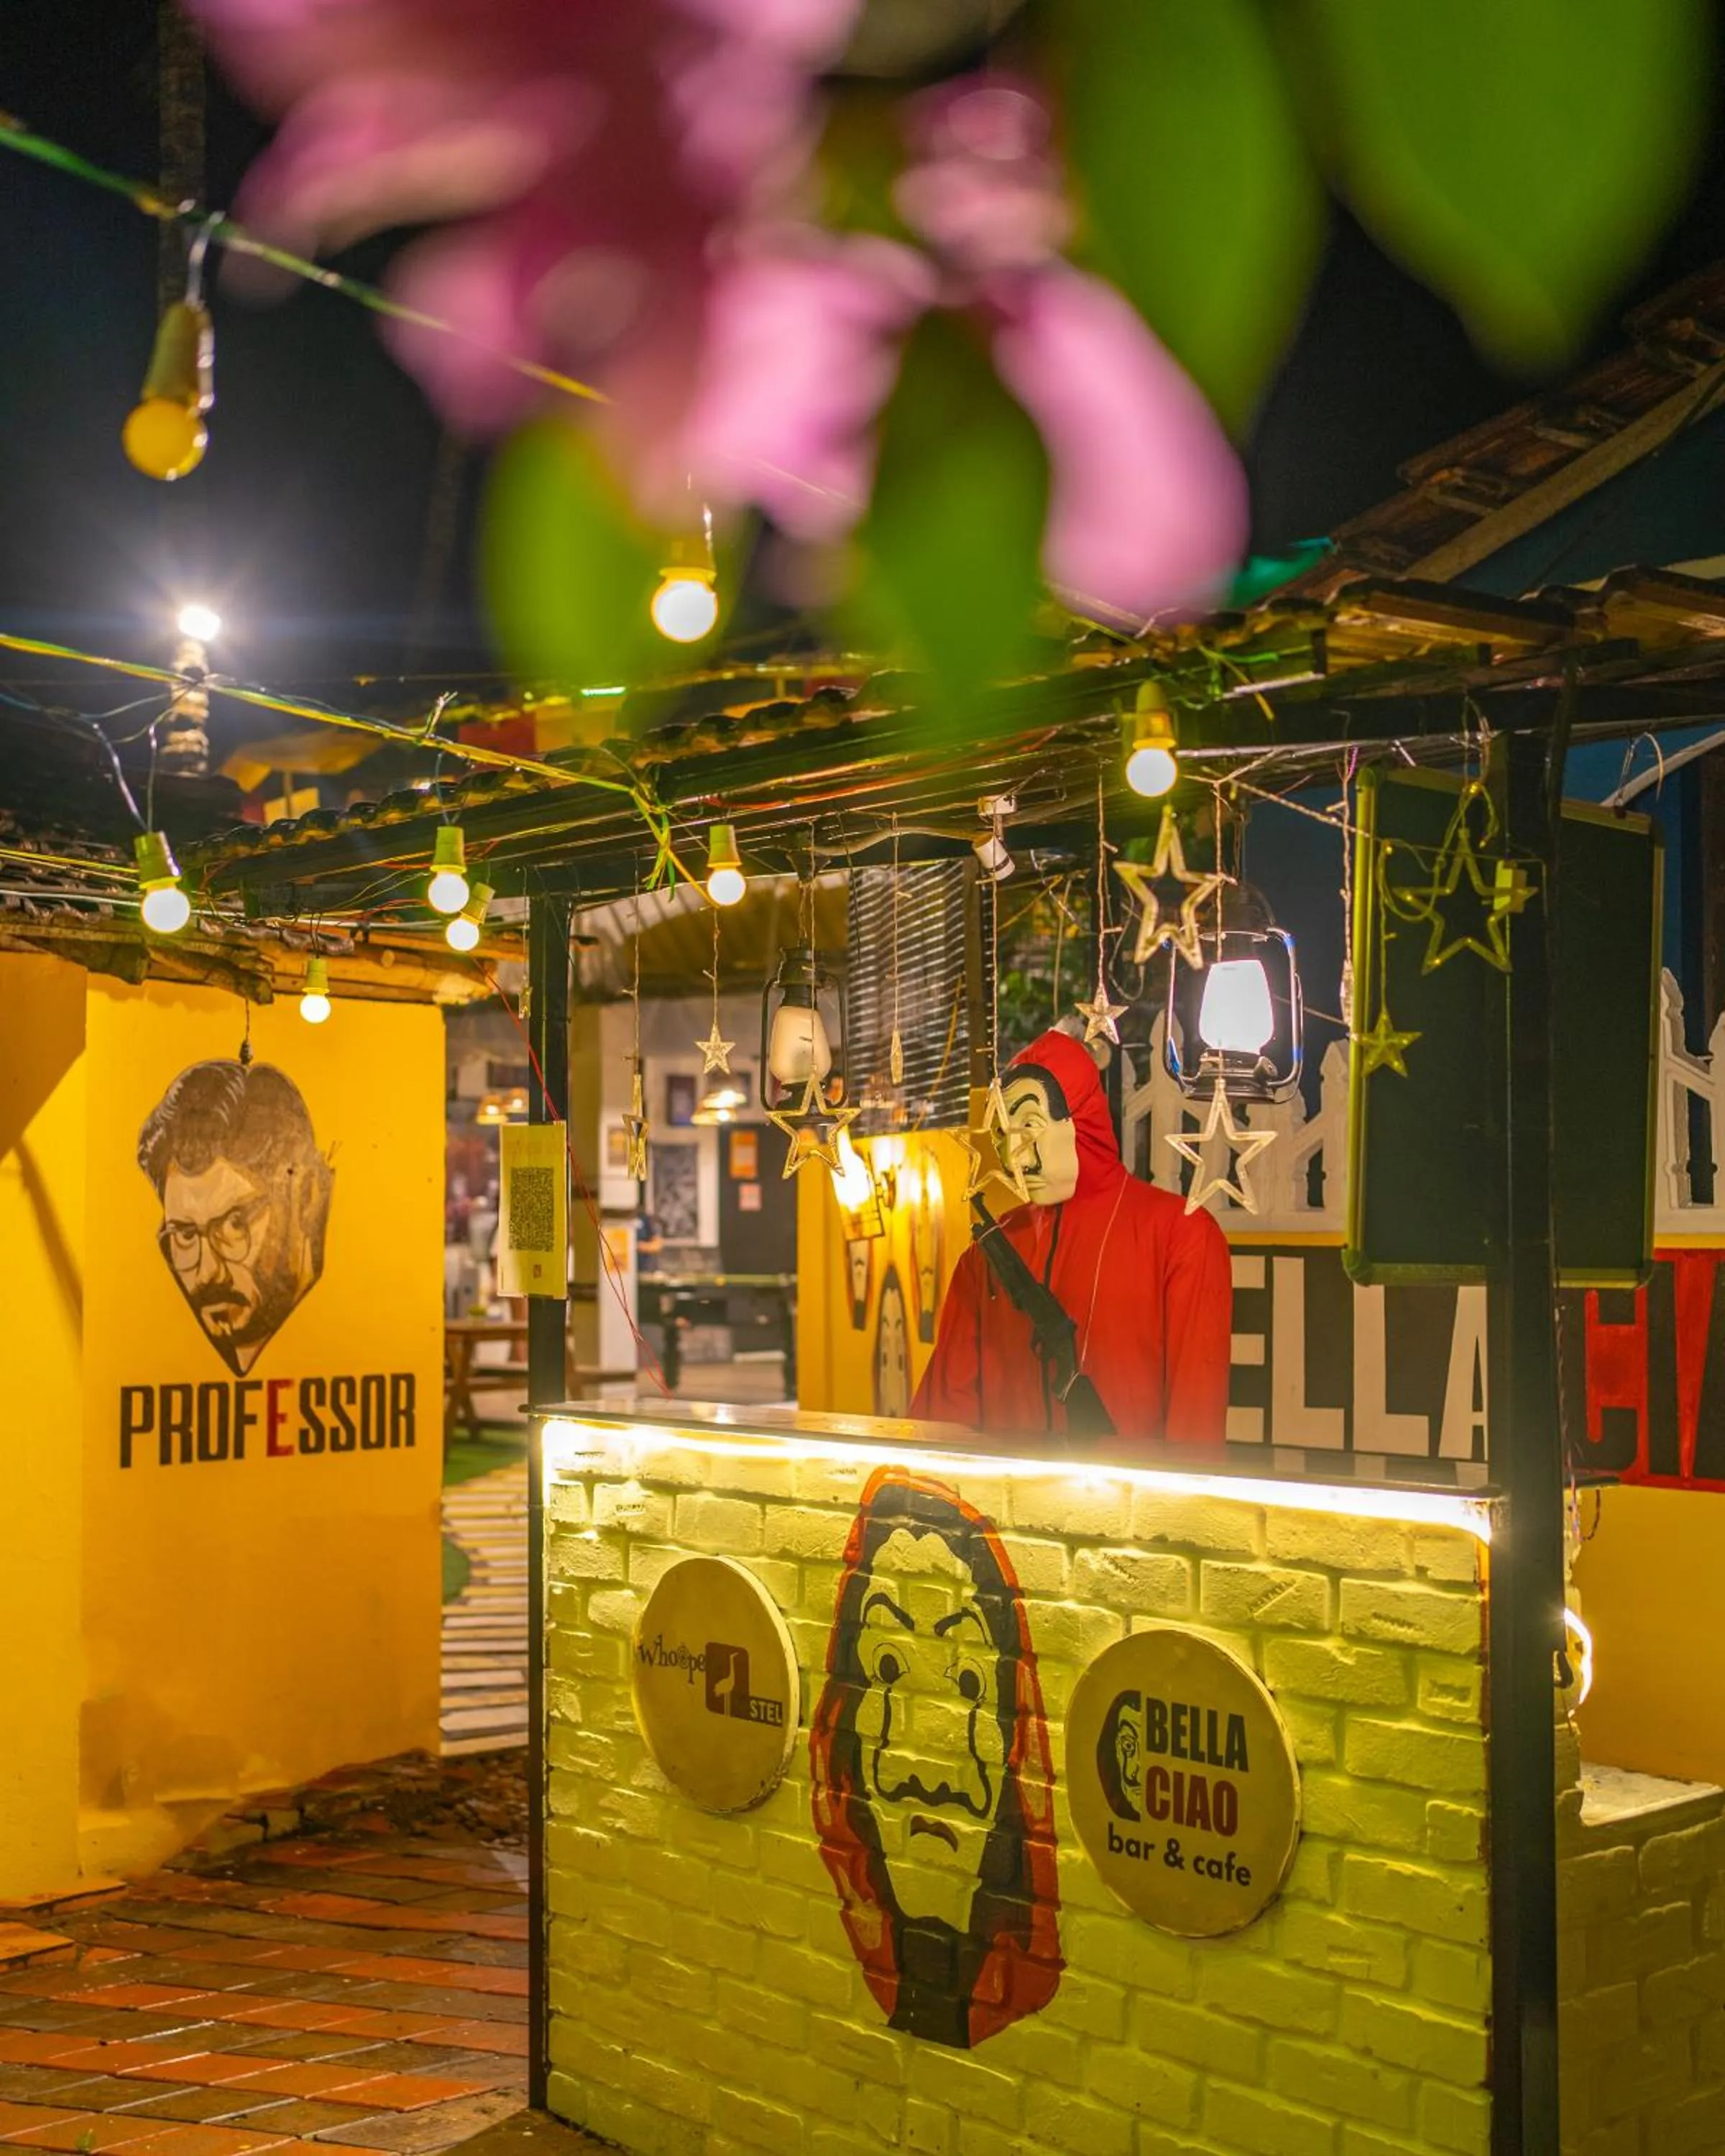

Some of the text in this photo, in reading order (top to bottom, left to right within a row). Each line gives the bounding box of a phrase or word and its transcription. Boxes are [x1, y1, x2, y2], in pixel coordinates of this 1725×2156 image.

[119, 1373, 416, 1469] PROFESSOR
[749, 1698, 783, 1724] STEL
[1146, 1697, 1249, 1773] BELLA
[1145, 1765, 1239, 1838] CIAO
[1107, 1821, 1252, 1886] bar & cafe
